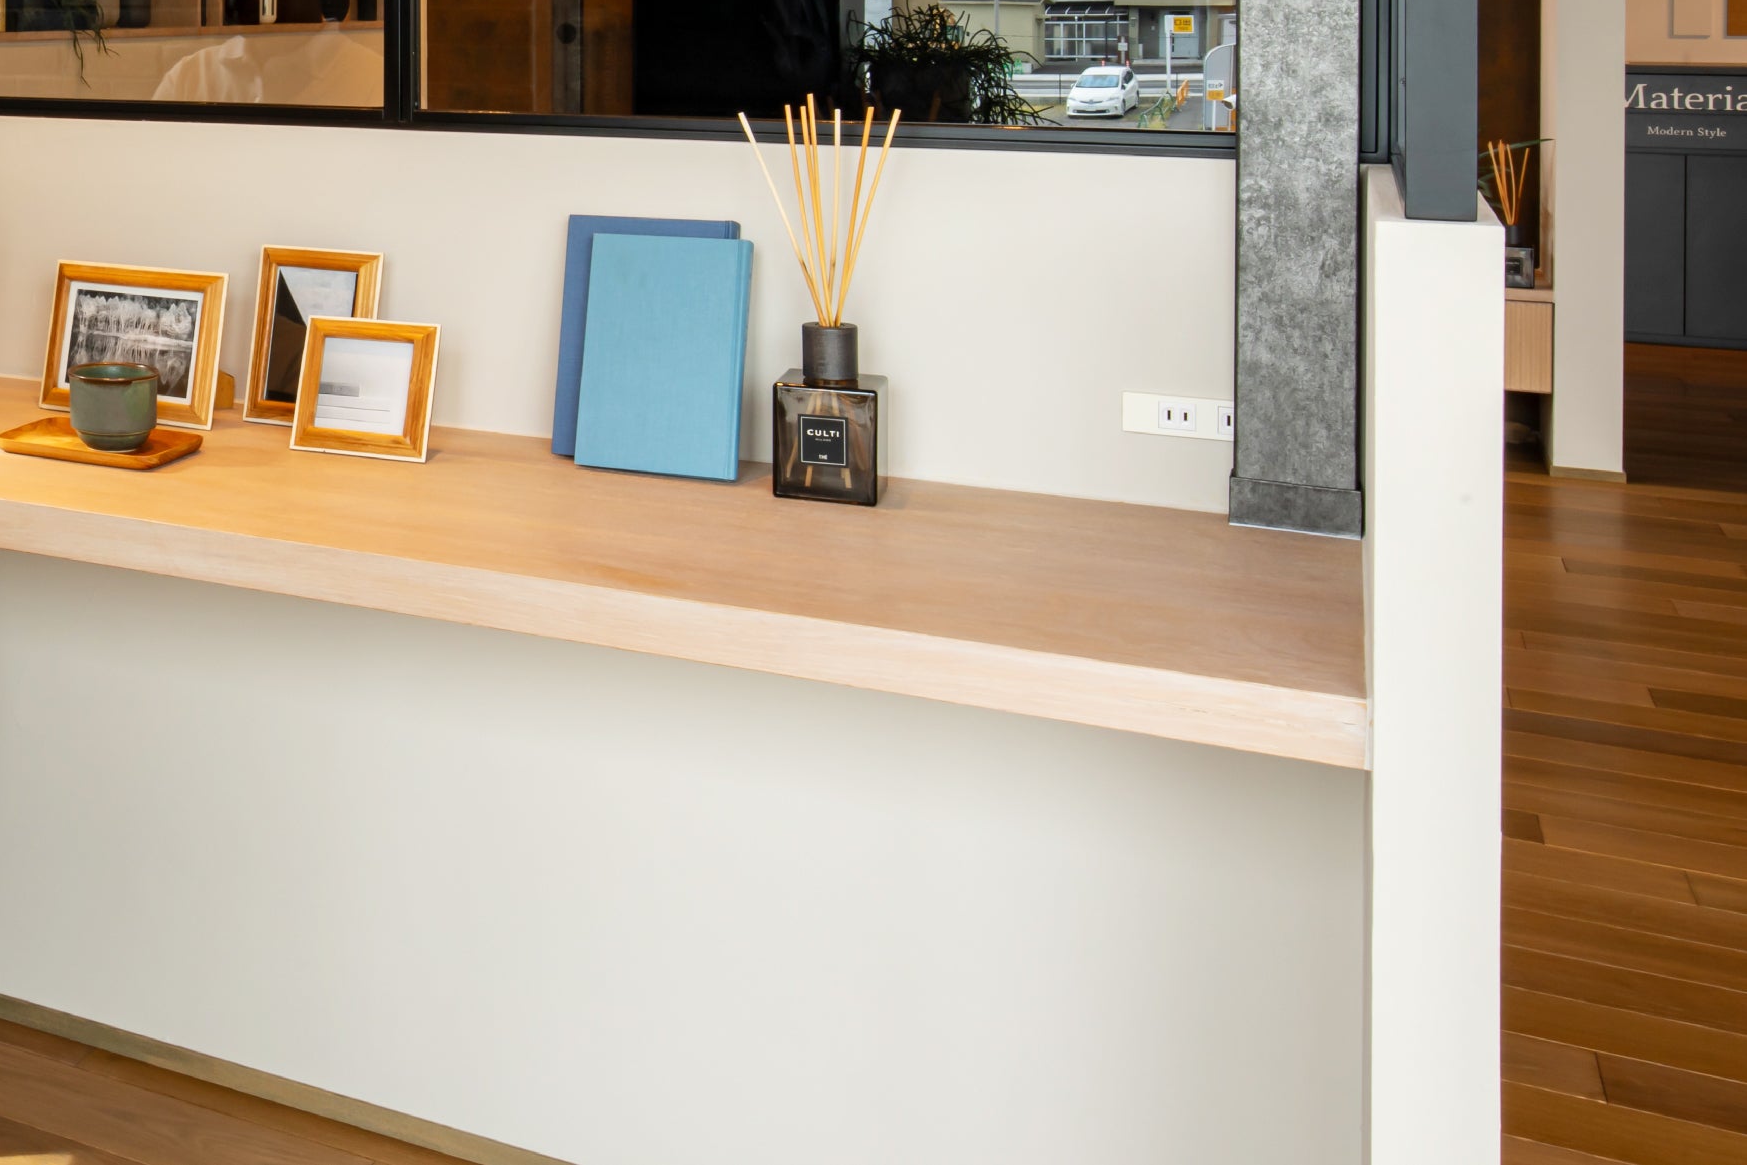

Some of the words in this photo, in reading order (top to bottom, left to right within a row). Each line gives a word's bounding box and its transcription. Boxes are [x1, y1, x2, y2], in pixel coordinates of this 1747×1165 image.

[1647, 125, 1694, 137] Modern
[1697, 126, 1727, 140] Style
[807, 428, 840, 438] CULTI
